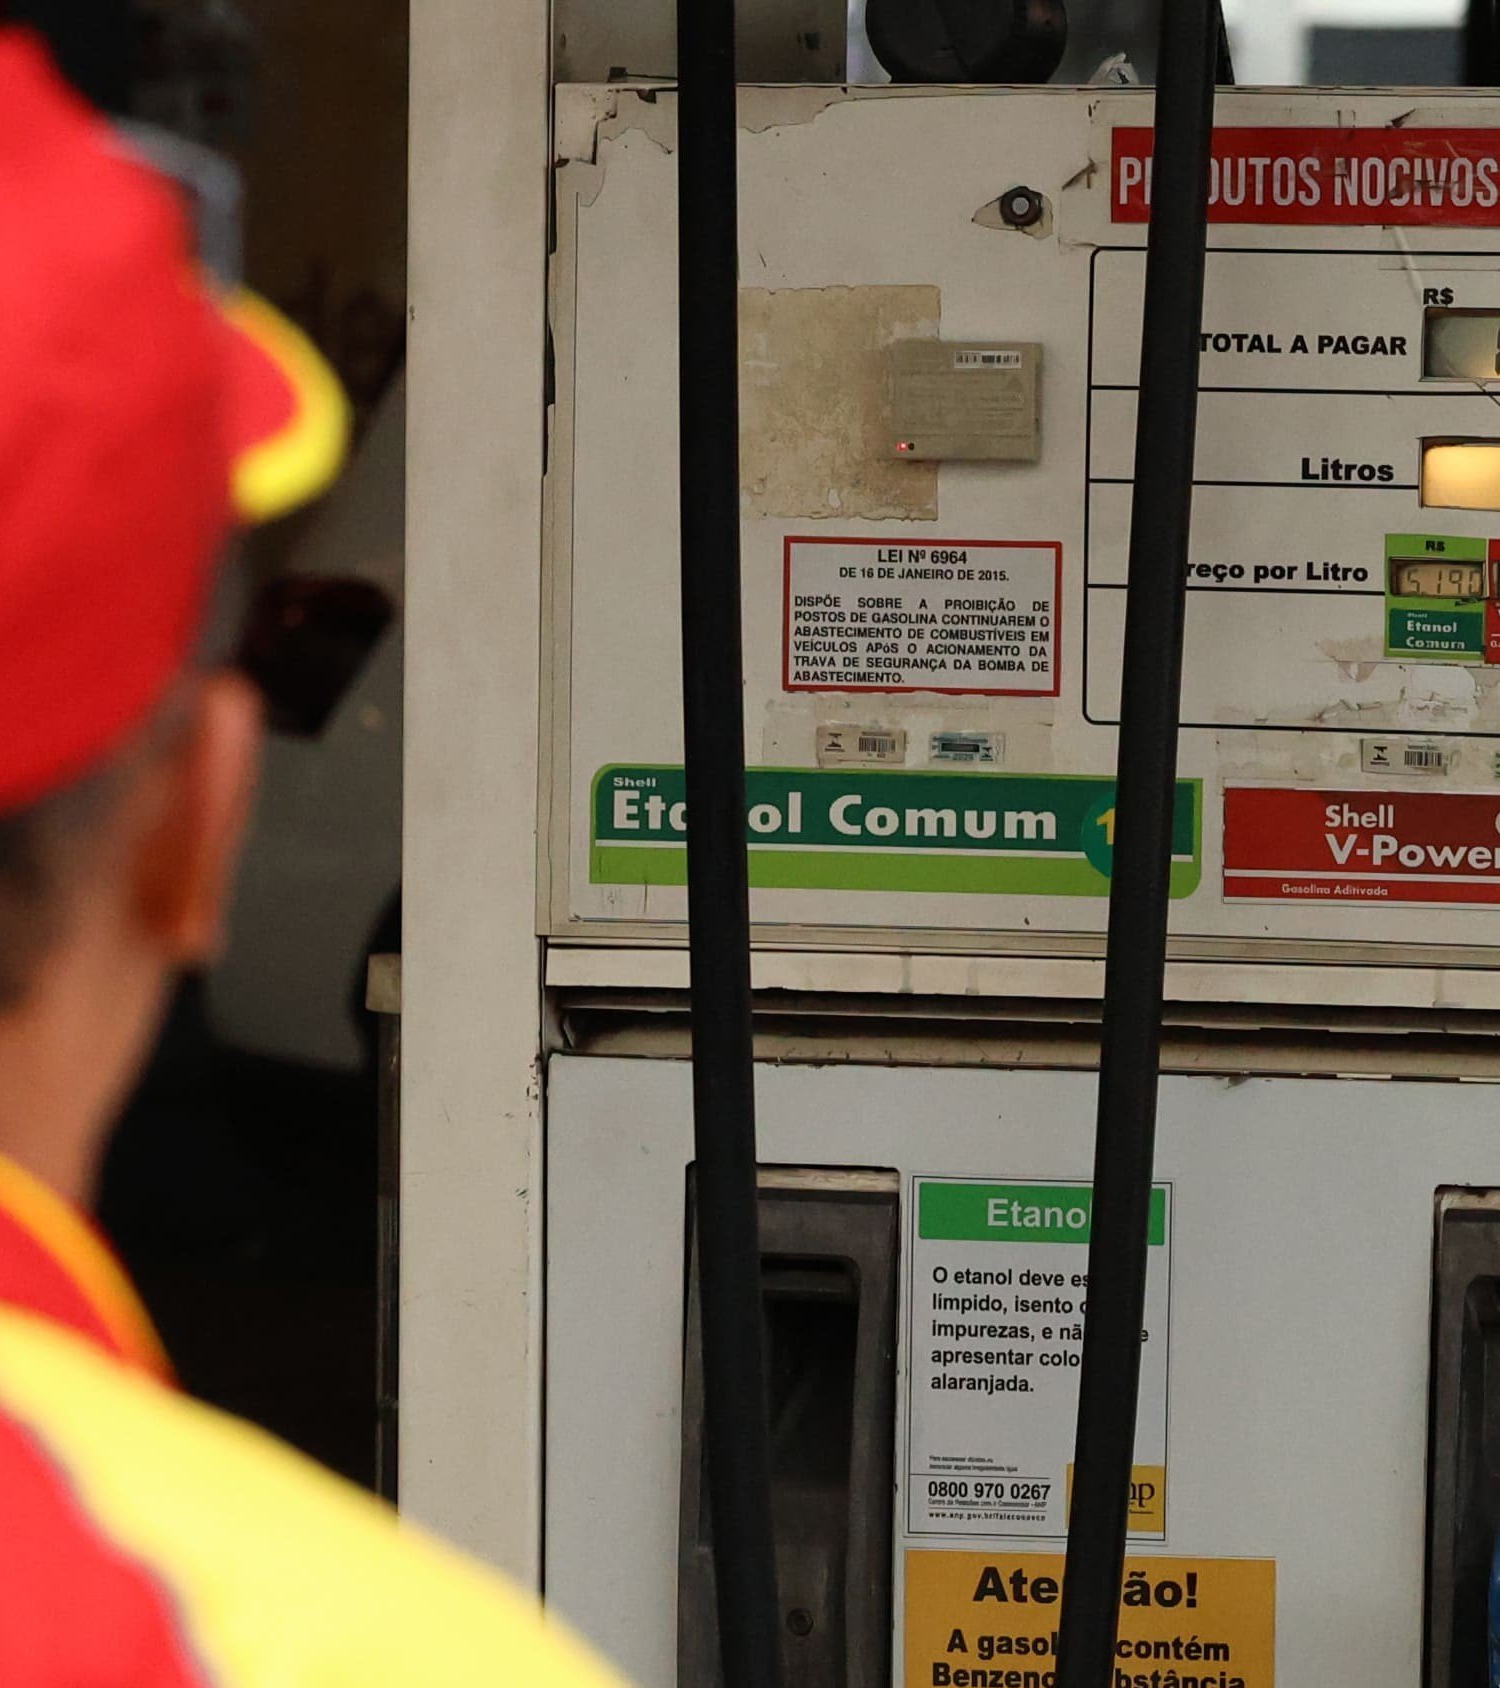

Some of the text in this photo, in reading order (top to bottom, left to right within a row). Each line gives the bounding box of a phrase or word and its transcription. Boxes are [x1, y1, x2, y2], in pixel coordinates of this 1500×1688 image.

[1335, 154, 1498, 207] NOCIVOS
[1423, 288, 1454, 305] R$
[1290, 335, 1308, 353] A
[1318, 335, 1406, 355] PAGAR
[1302, 458, 1393, 481] Litros
[878, 549, 902, 563] LEI
[931, 550, 967, 564] 6964
[840, 567, 1009, 581] DE 16 DE JANEIRO DE 2015.
[1186, 562, 1368, 584] reço por Litro
[795, 594, 1049, 613] DISPÕE SOBRE A PROIBIÇÃO DE
[1407, 620, 1456, 632] Etanol
[614, 777, 656, 787] Shell
[613, 790, 1056, 840] Etaol Comum
[1325, 804, 1393, 828] Shell
[1282, 884, 1387, 895] Gasolina Aditivada
[987, 1198, 1089, 1230] Etano
[933, 1267, 1064, 1286] O etanol deve
[933, 1293, 1073, 1314] límpido, isento
[932, 1320, 1052, 1342] impurezas, e
[931, 1349, 1033, 1367] apresentar
[931, 1373, 1034, 1395] alaranjada.
[929, 1481, 1051, 1500] 0800 970 0267
